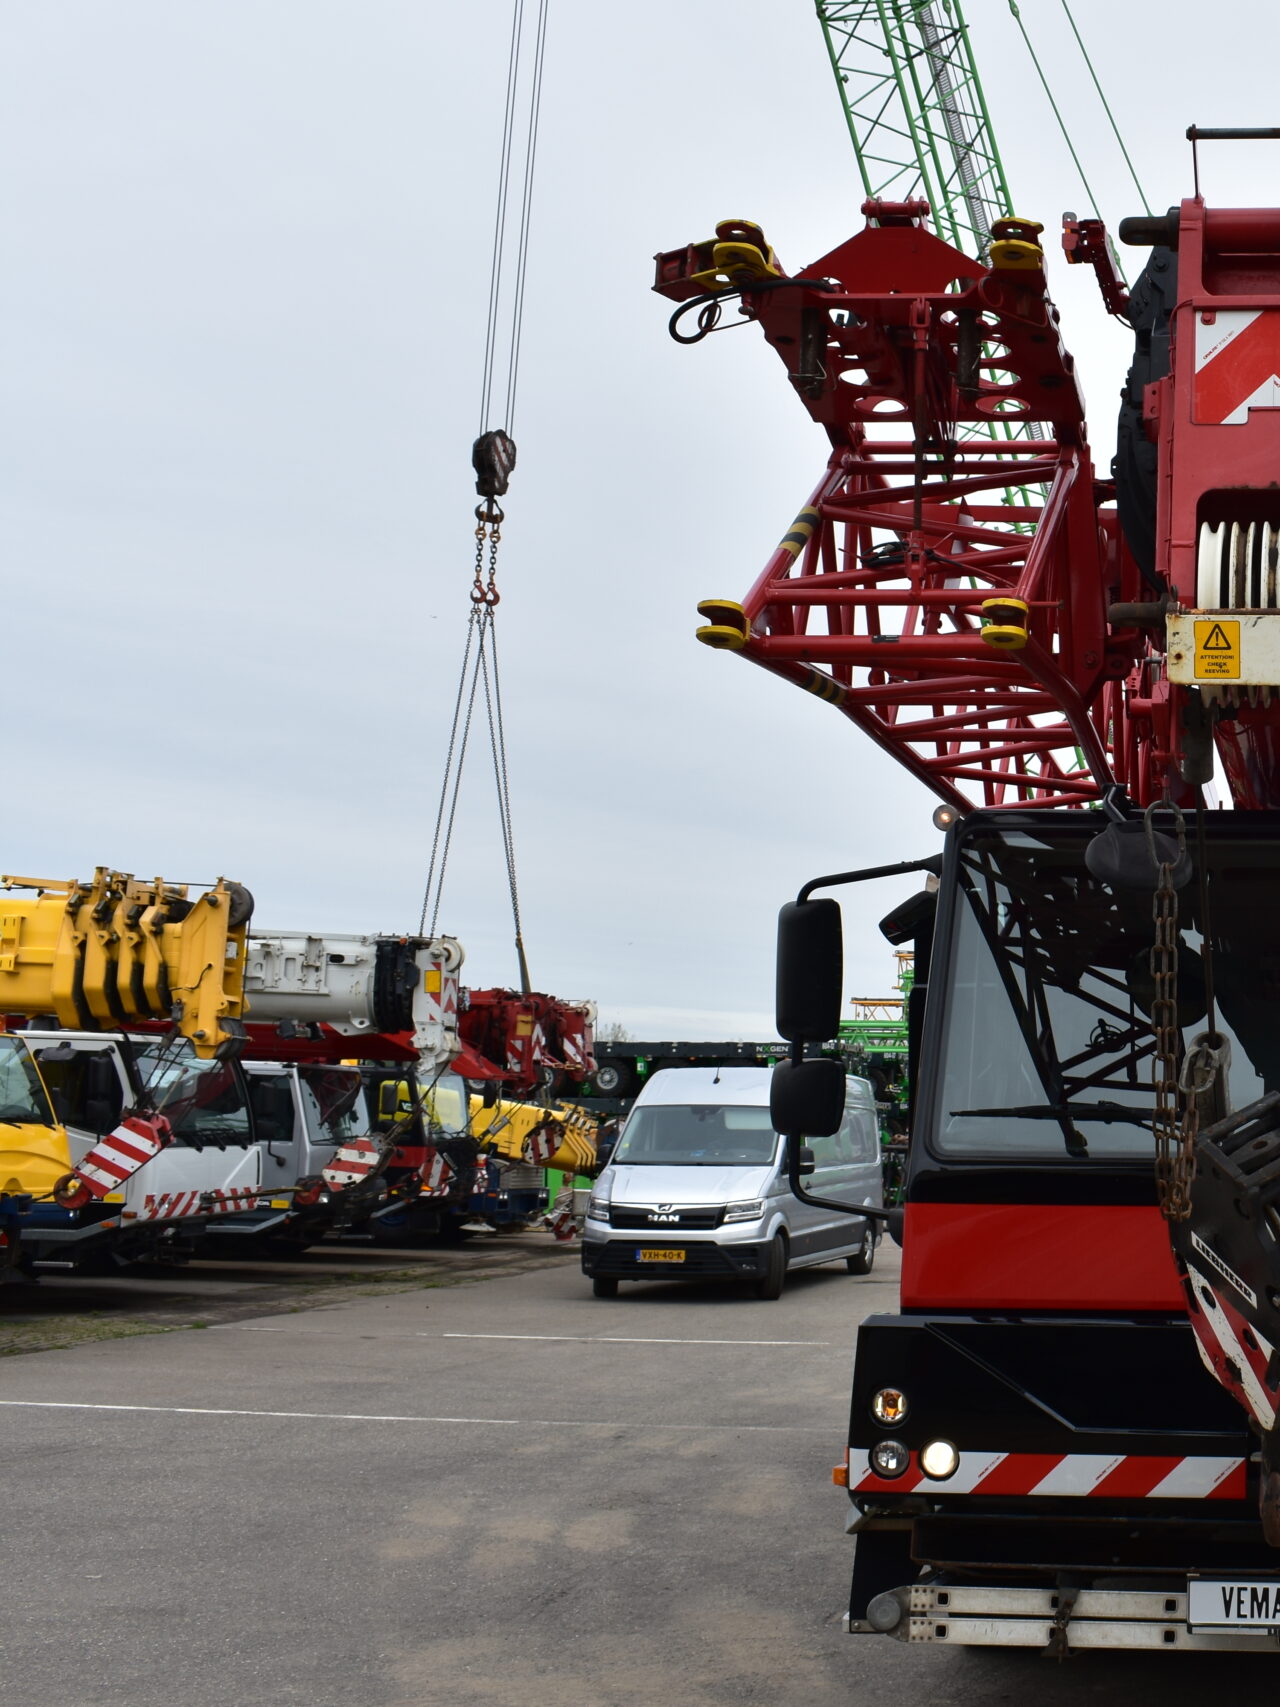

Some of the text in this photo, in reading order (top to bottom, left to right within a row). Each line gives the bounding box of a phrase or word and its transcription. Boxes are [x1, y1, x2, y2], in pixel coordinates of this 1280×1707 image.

[756, 1045, 789, 1053] NXGEN
[641, 1251, 684, 1260] VXH-40-K
[1195, 1238, 1253, 1300] LIEBHERR
